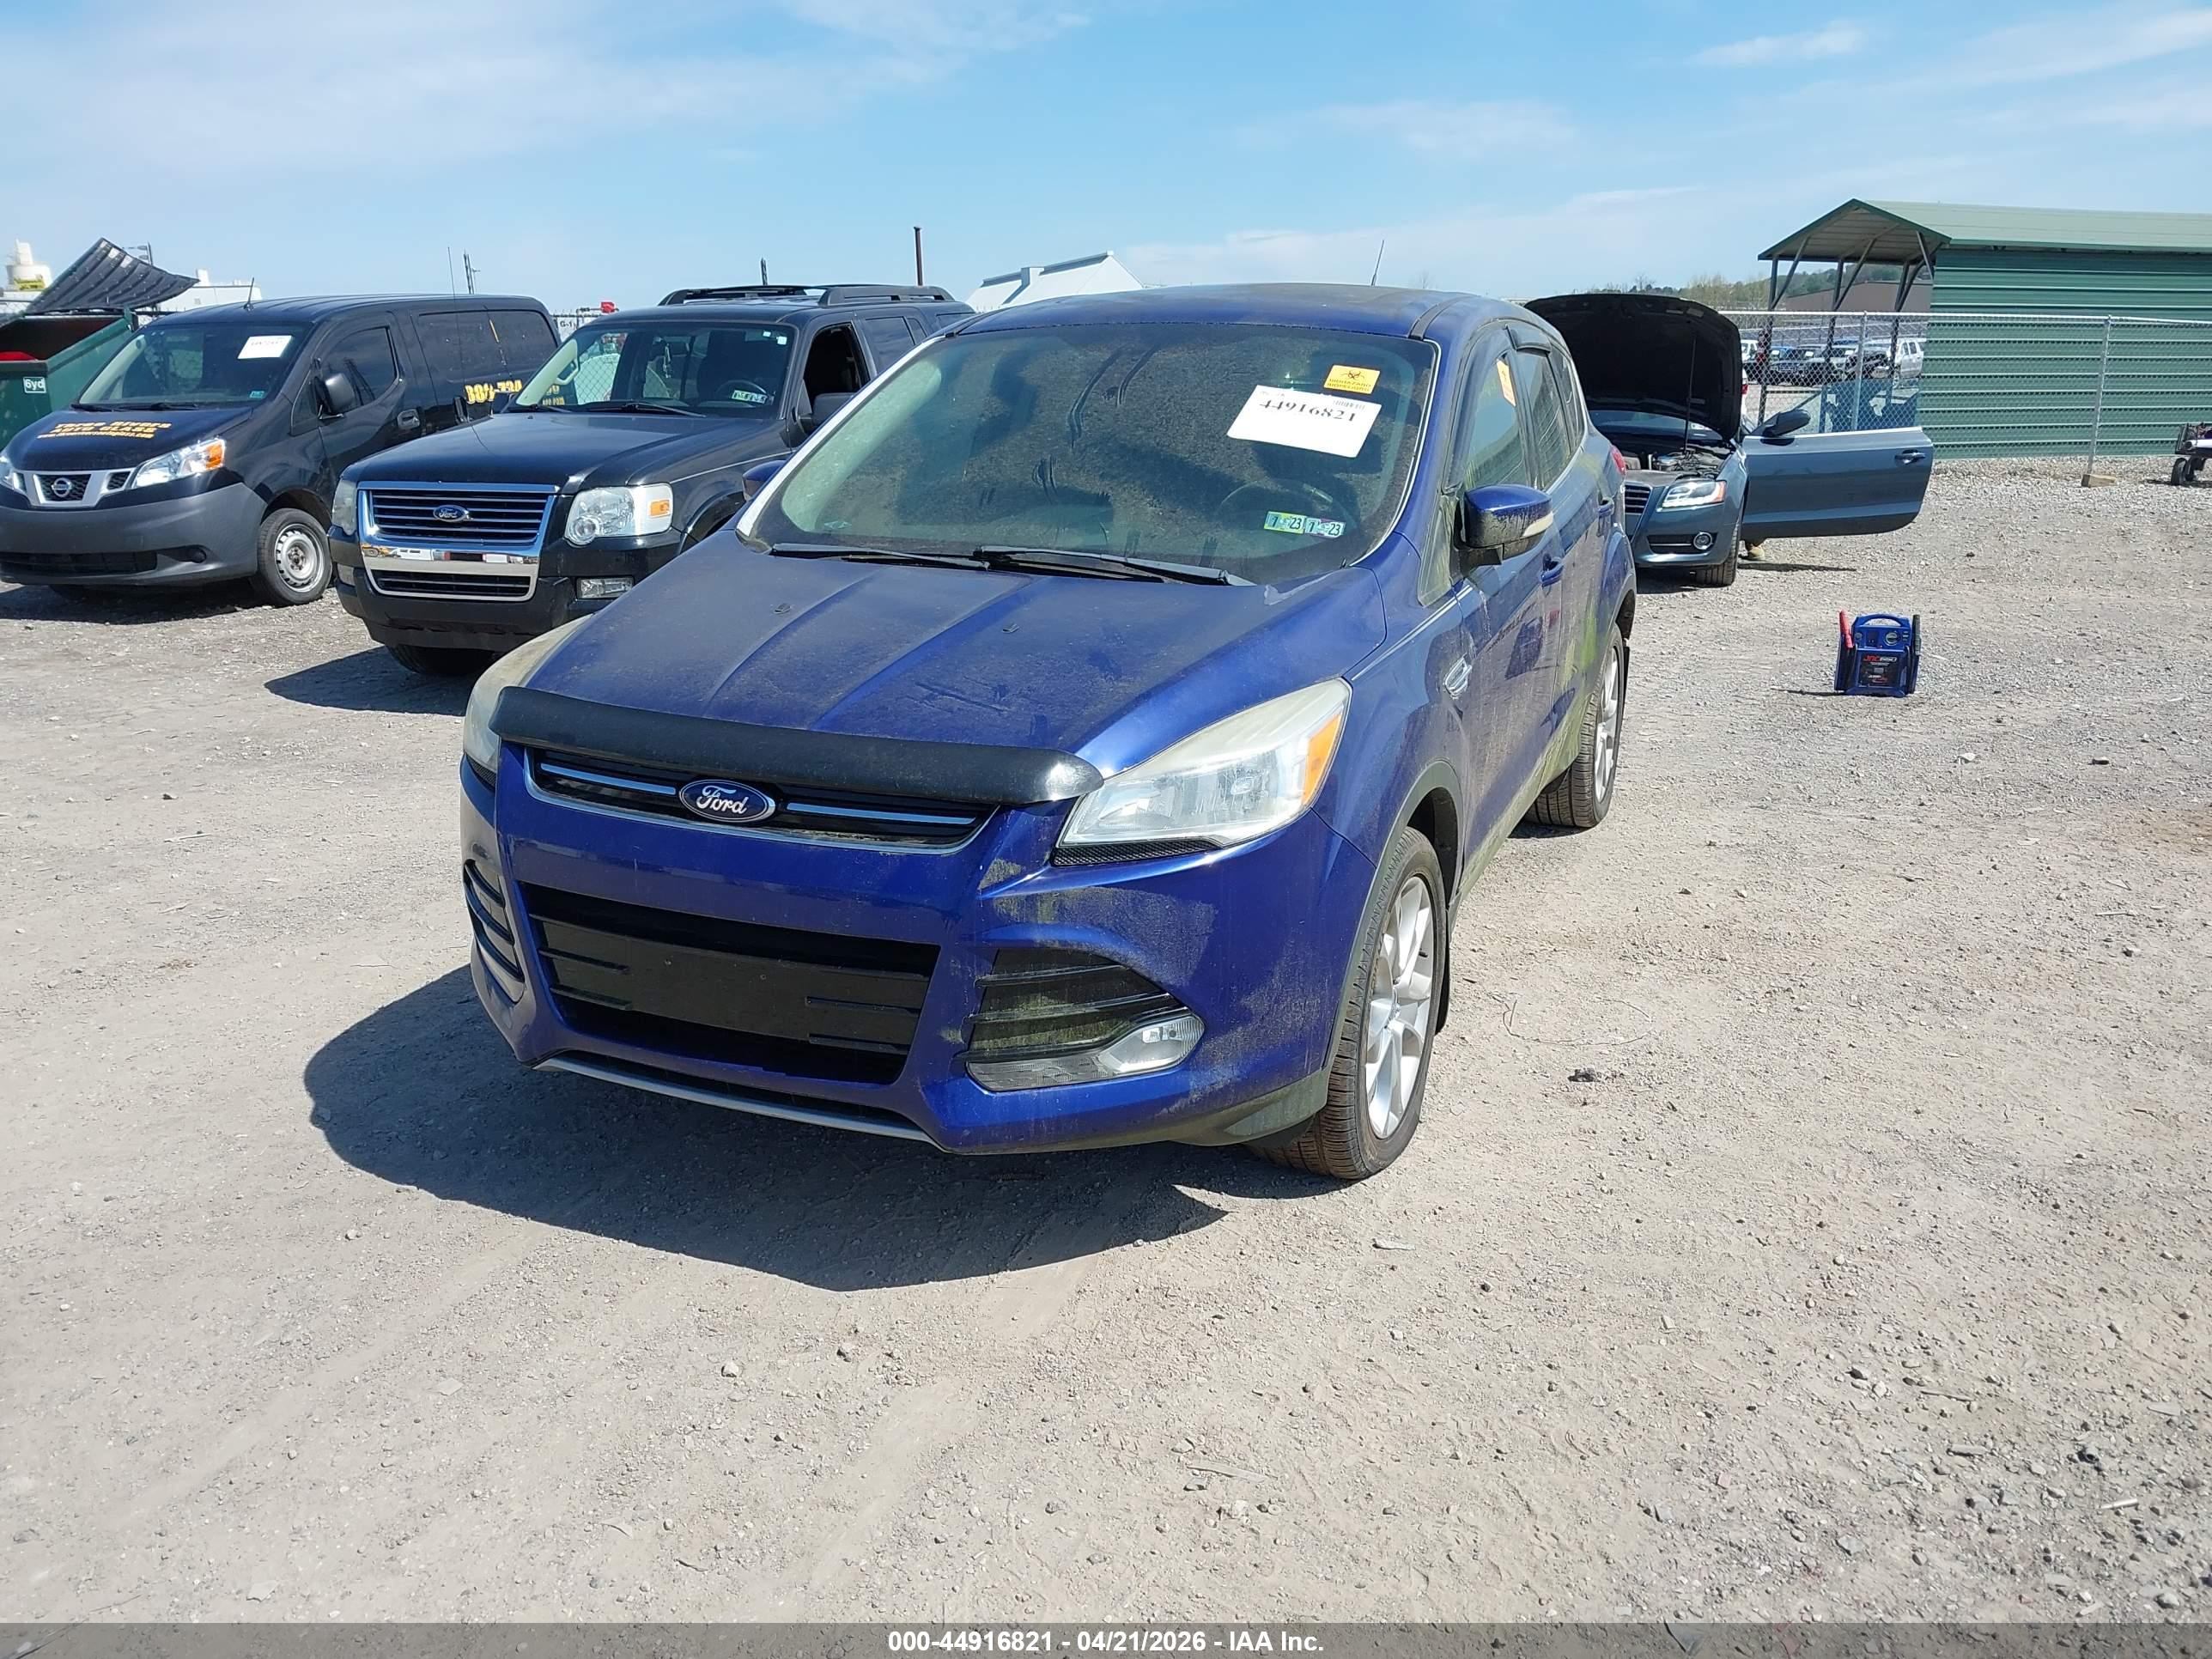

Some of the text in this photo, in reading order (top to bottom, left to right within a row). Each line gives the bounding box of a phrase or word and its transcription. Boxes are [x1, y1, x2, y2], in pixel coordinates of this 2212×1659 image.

[25, 378, 45, 392] 6yd
[1260, 398, 1357, 422] 44916821
[1290, 517, 1303, 530] 23
[1328, 523, 1341, 536] 23
[696, 785, 750, 815] Ford
